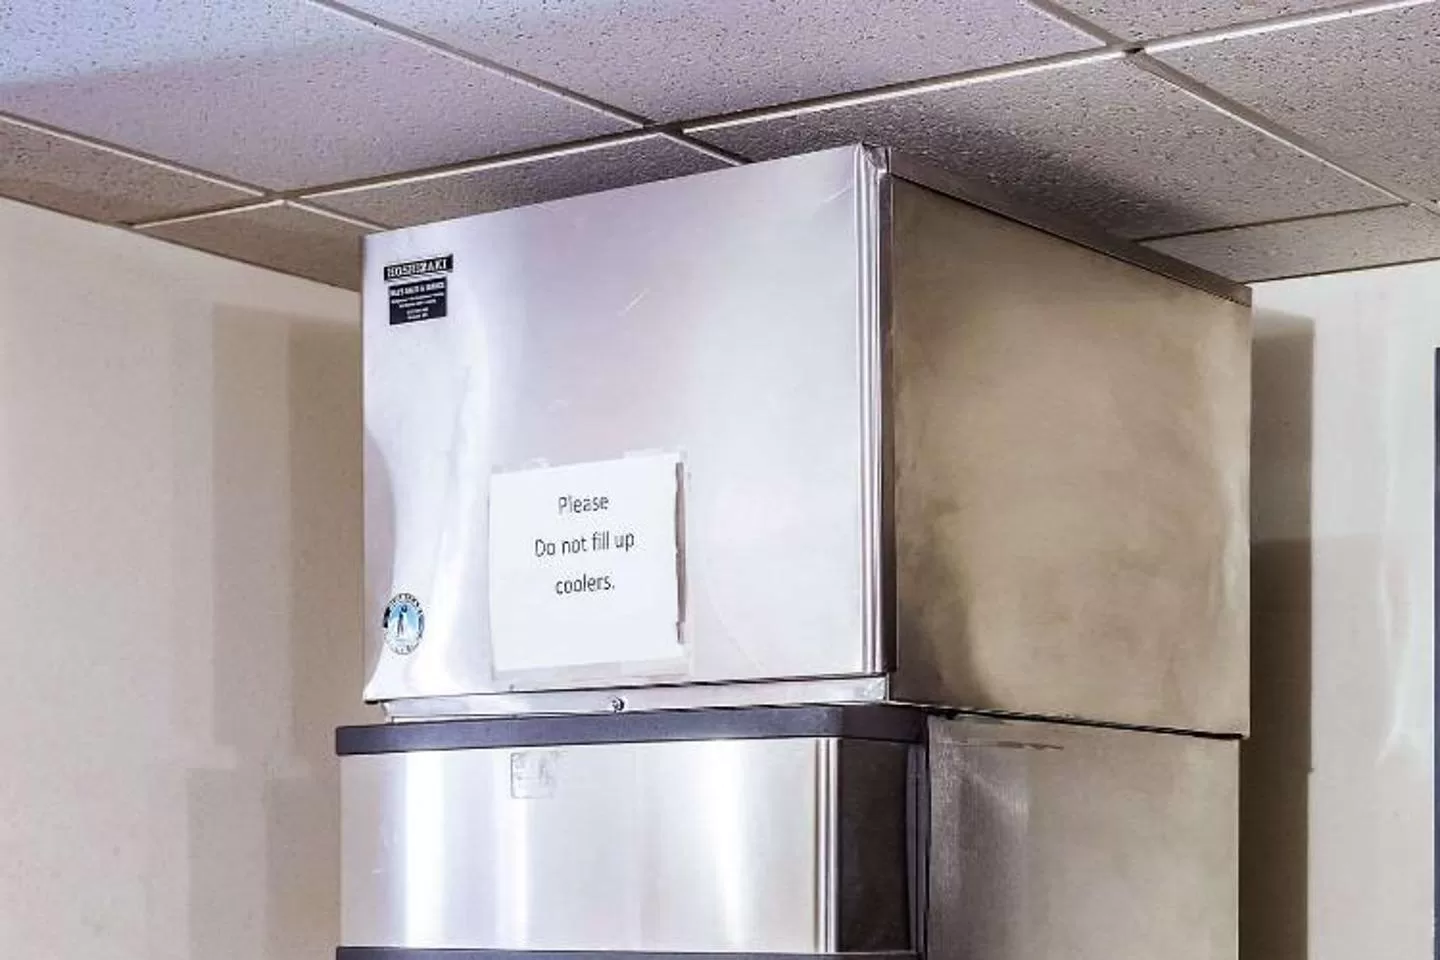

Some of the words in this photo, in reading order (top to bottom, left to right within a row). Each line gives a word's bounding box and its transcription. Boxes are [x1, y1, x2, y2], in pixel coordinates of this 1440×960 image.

[558, 495, 609, 515] Please
[535, 538, 556, 558] Do
[562, 536, 587, 556] not
[592, 530, 609, 551] fill
[614, 532, 635, 552] up
[555, 573, 615, 595] coolers.
